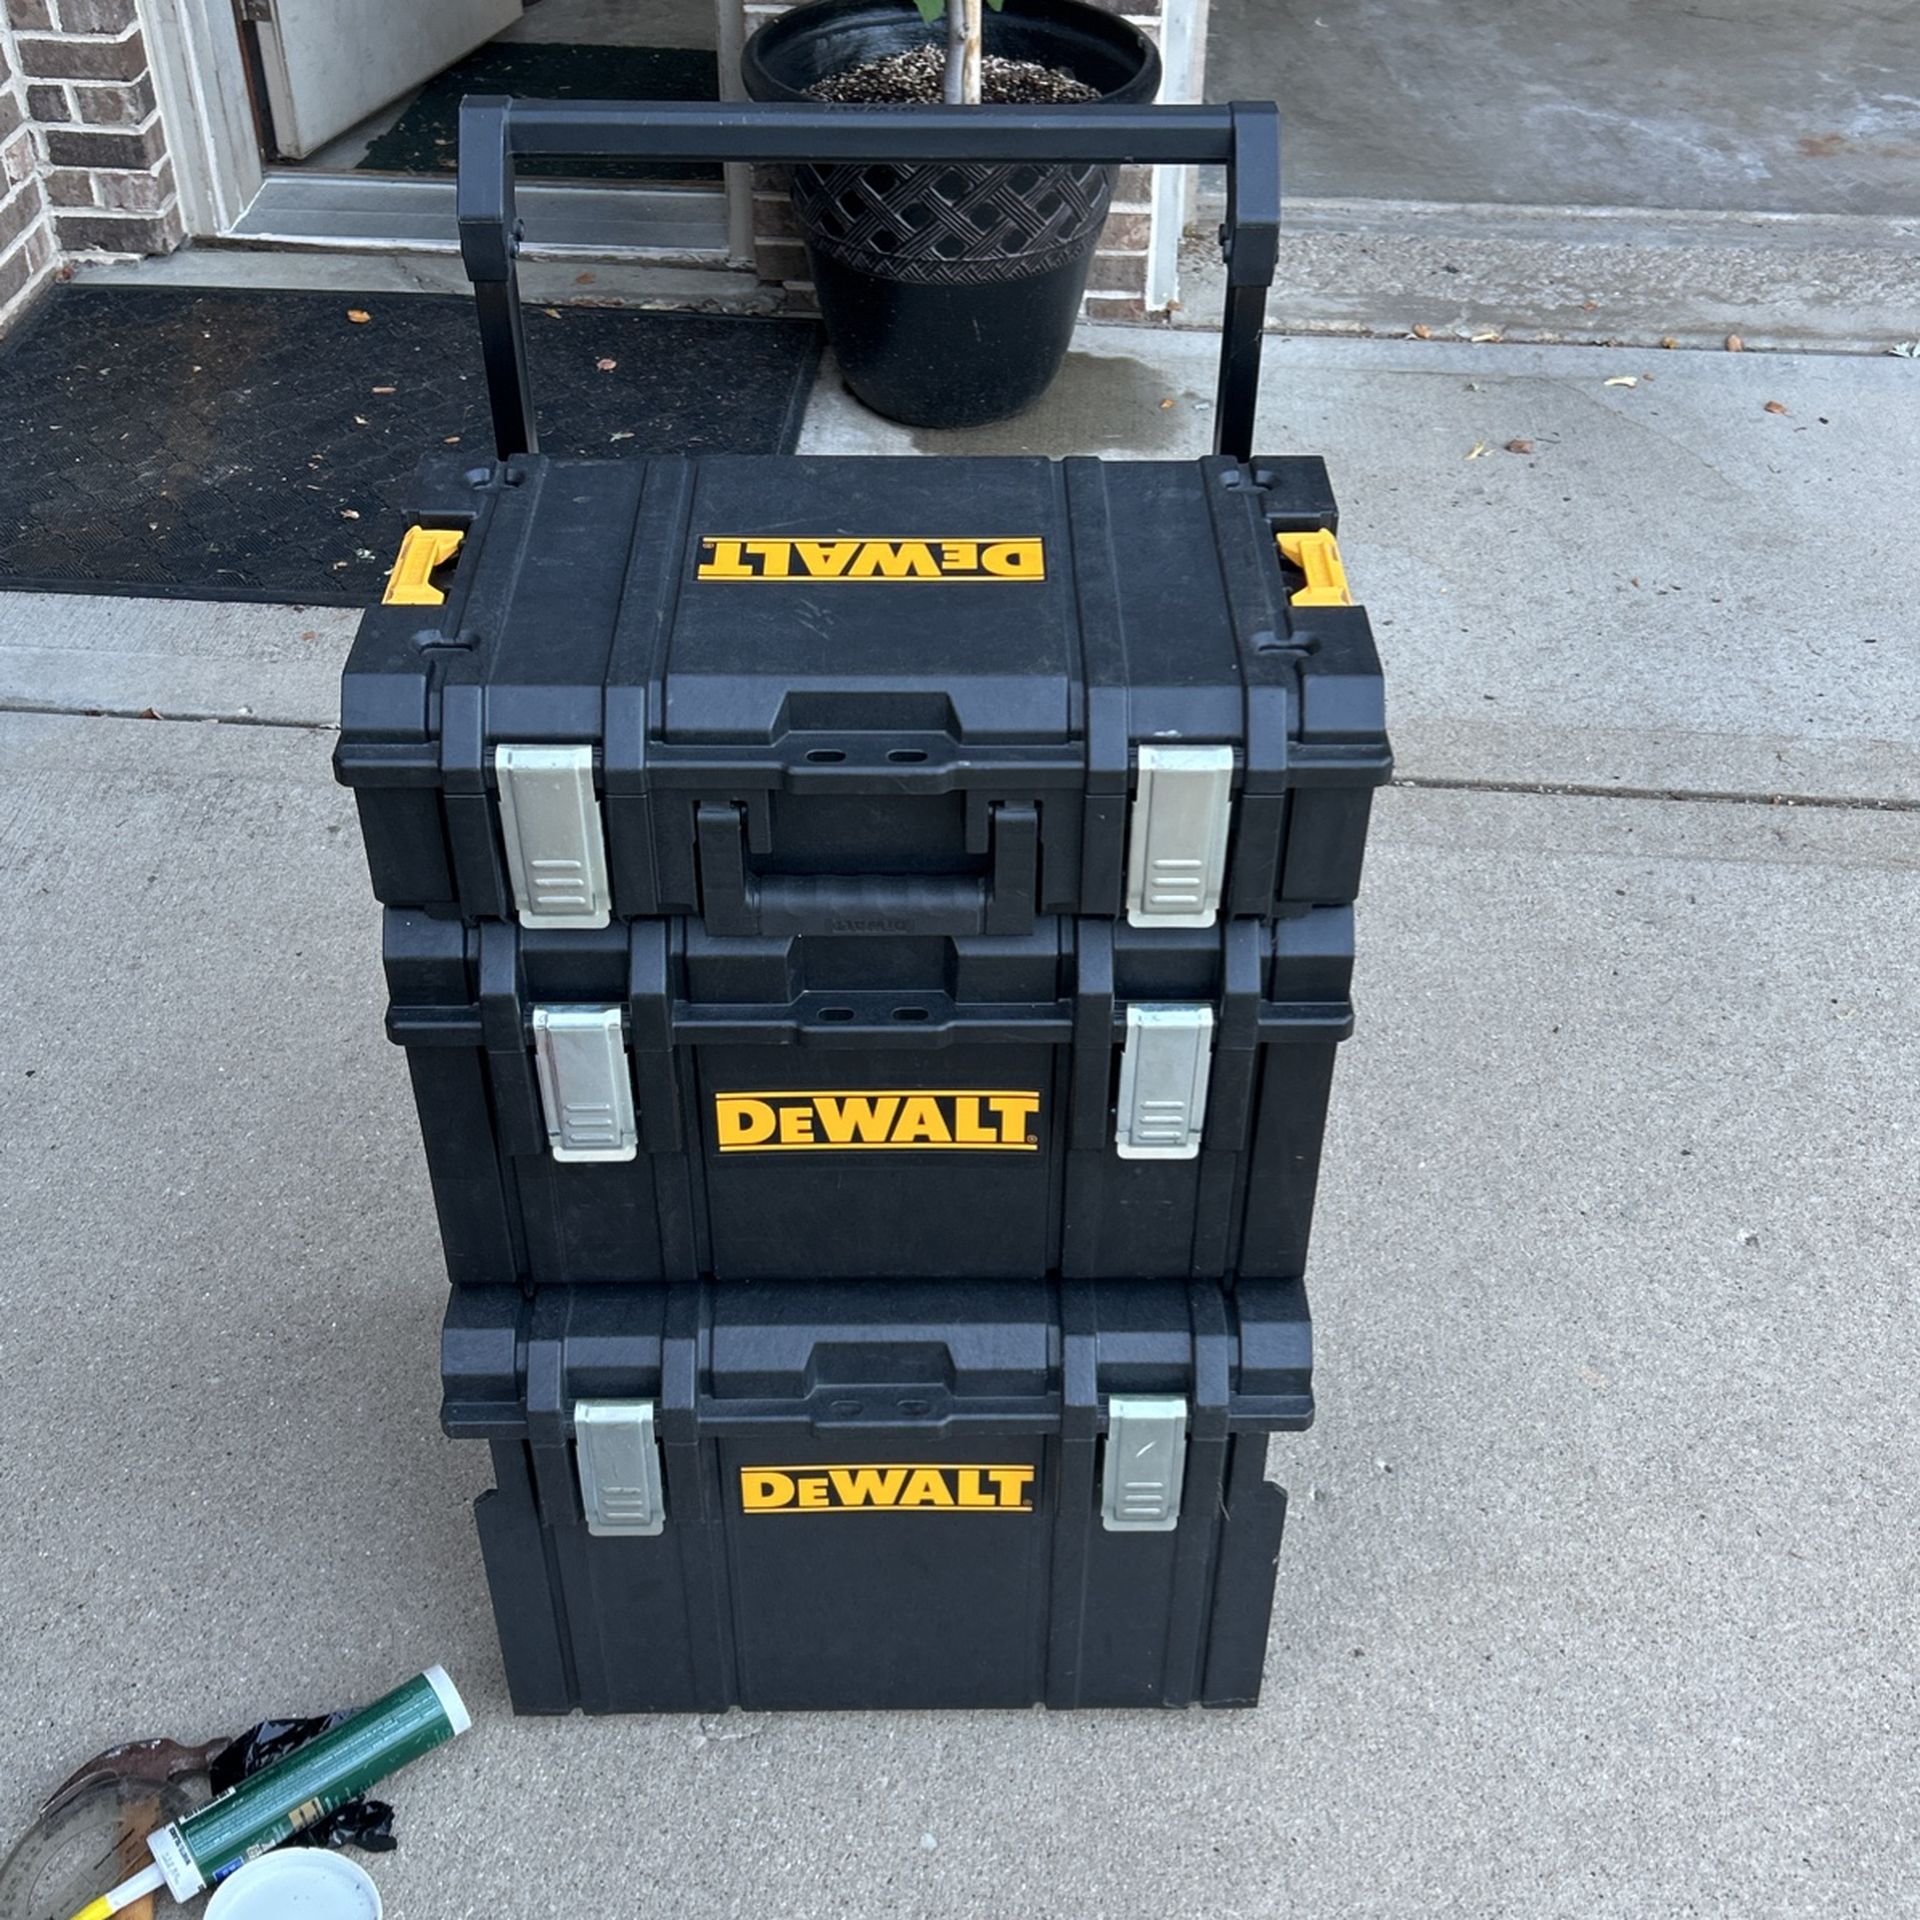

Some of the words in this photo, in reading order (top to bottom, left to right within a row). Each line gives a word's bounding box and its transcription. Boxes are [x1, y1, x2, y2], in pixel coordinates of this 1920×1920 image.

[698, 542, 1044, 577] DEWALT
[716, 1097, 1039, 1145] DEWALT
[741, 1469, 1034, 1508] DEWALT
